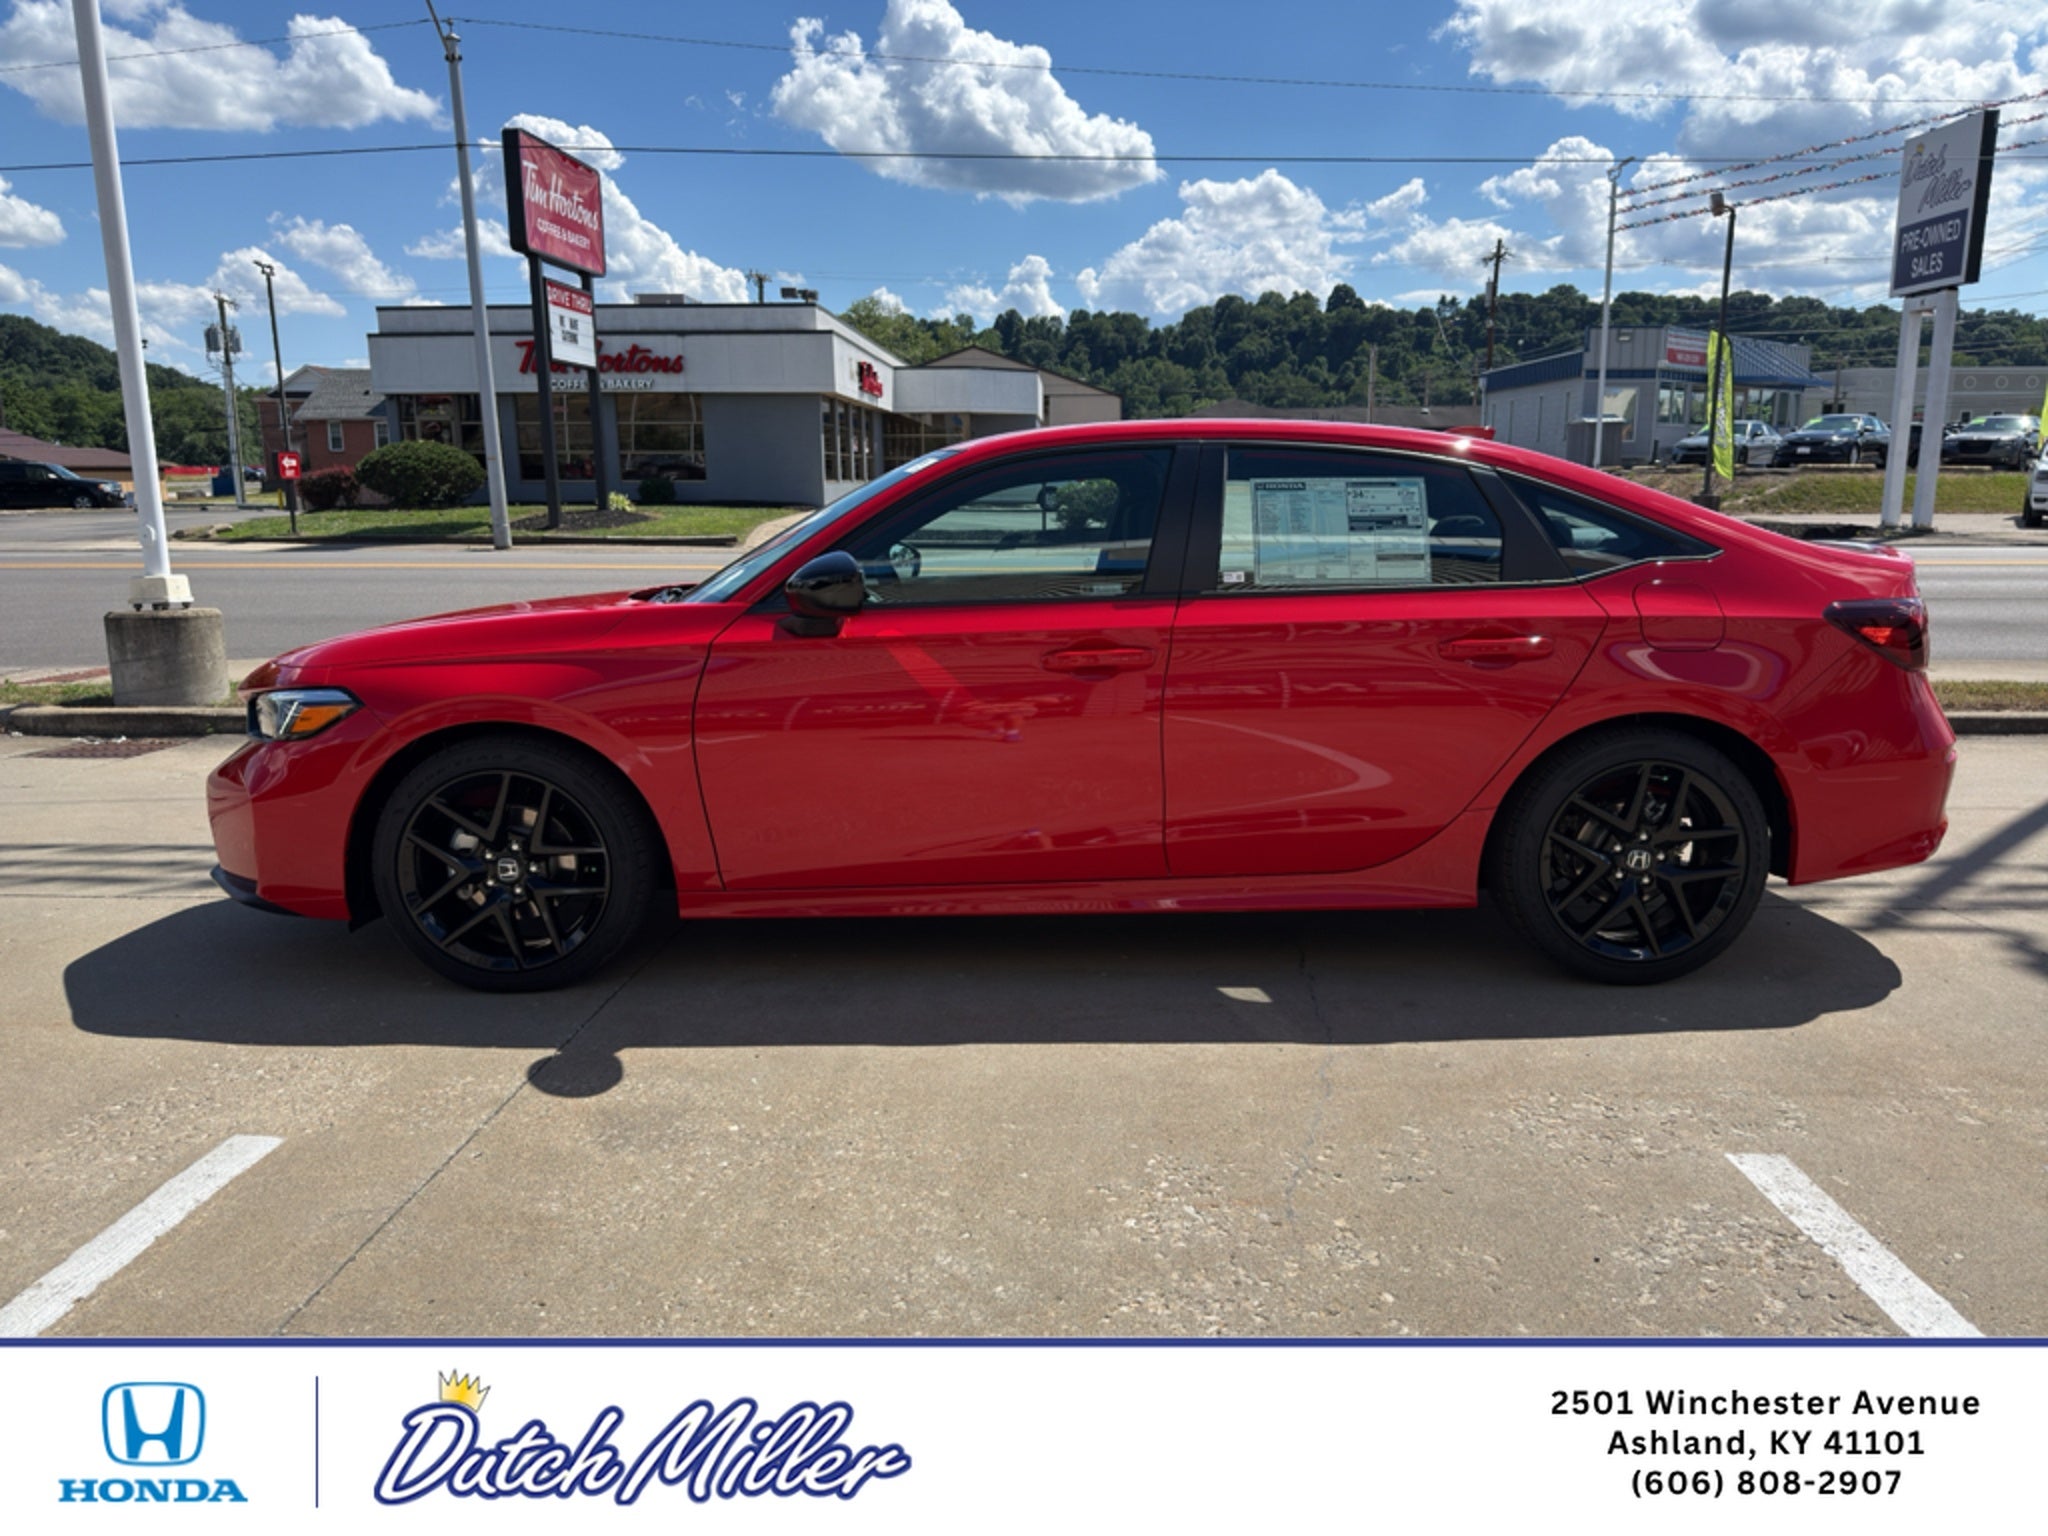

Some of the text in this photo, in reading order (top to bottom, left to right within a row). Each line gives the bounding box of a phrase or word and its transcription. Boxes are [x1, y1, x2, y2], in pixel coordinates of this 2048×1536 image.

[522, 160, 599, 230] Tim Hortons
[1901, 219, 1961, 253] PRE-OWNED
[1911, 251, 1944, 278] SALES
[547, 285, 571, 307] DRIVE
[572, 338, 683, 374] ortons
[607, 379, 654, 389] BAKERY
